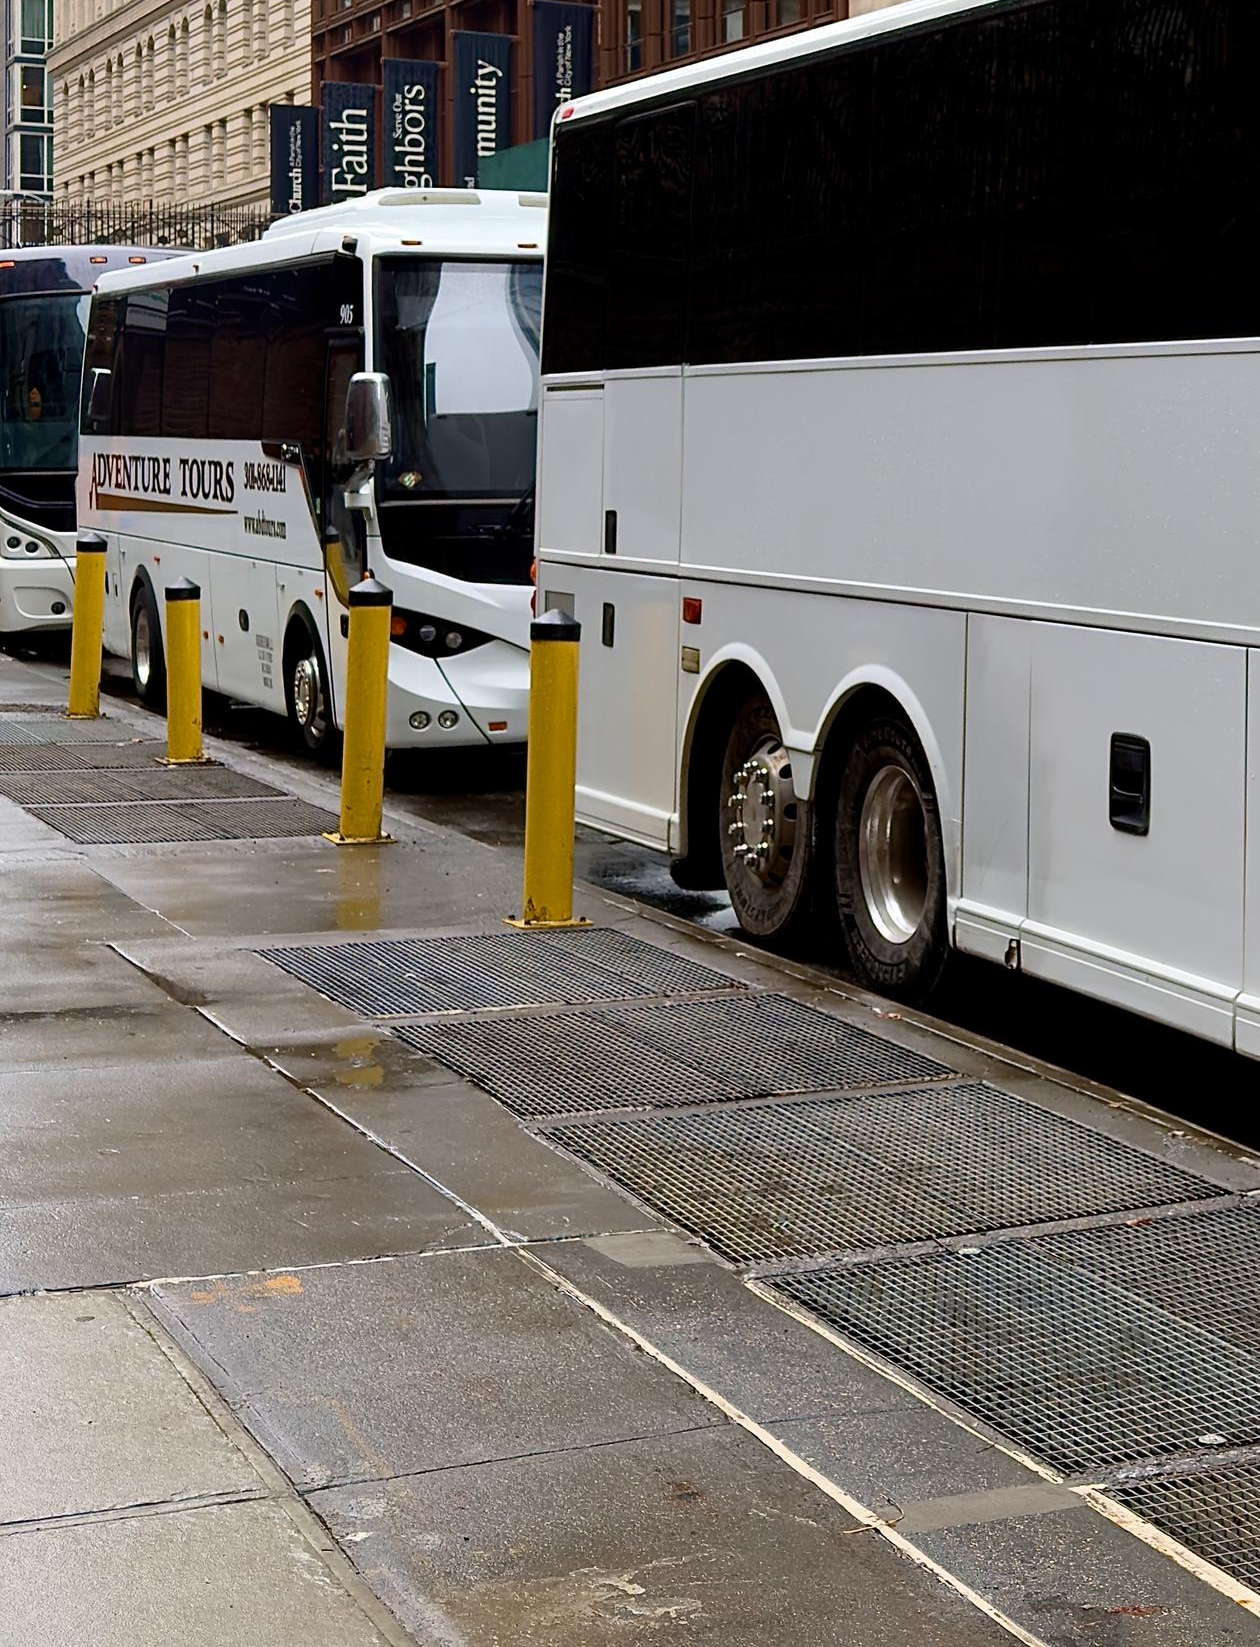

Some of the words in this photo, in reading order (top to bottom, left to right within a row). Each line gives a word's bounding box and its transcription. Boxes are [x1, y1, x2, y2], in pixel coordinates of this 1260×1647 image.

[393, 93, 402, 112] Our
[393, 113, 402, 139] Serve
[329, 109, 368, 193] Faith
[288, 168, 302, 214] Church
[340, 304, 354, 324] 905
[88, 452, 171, 510] ADVENTURE
[179, 458, 235, 503] TOURS
